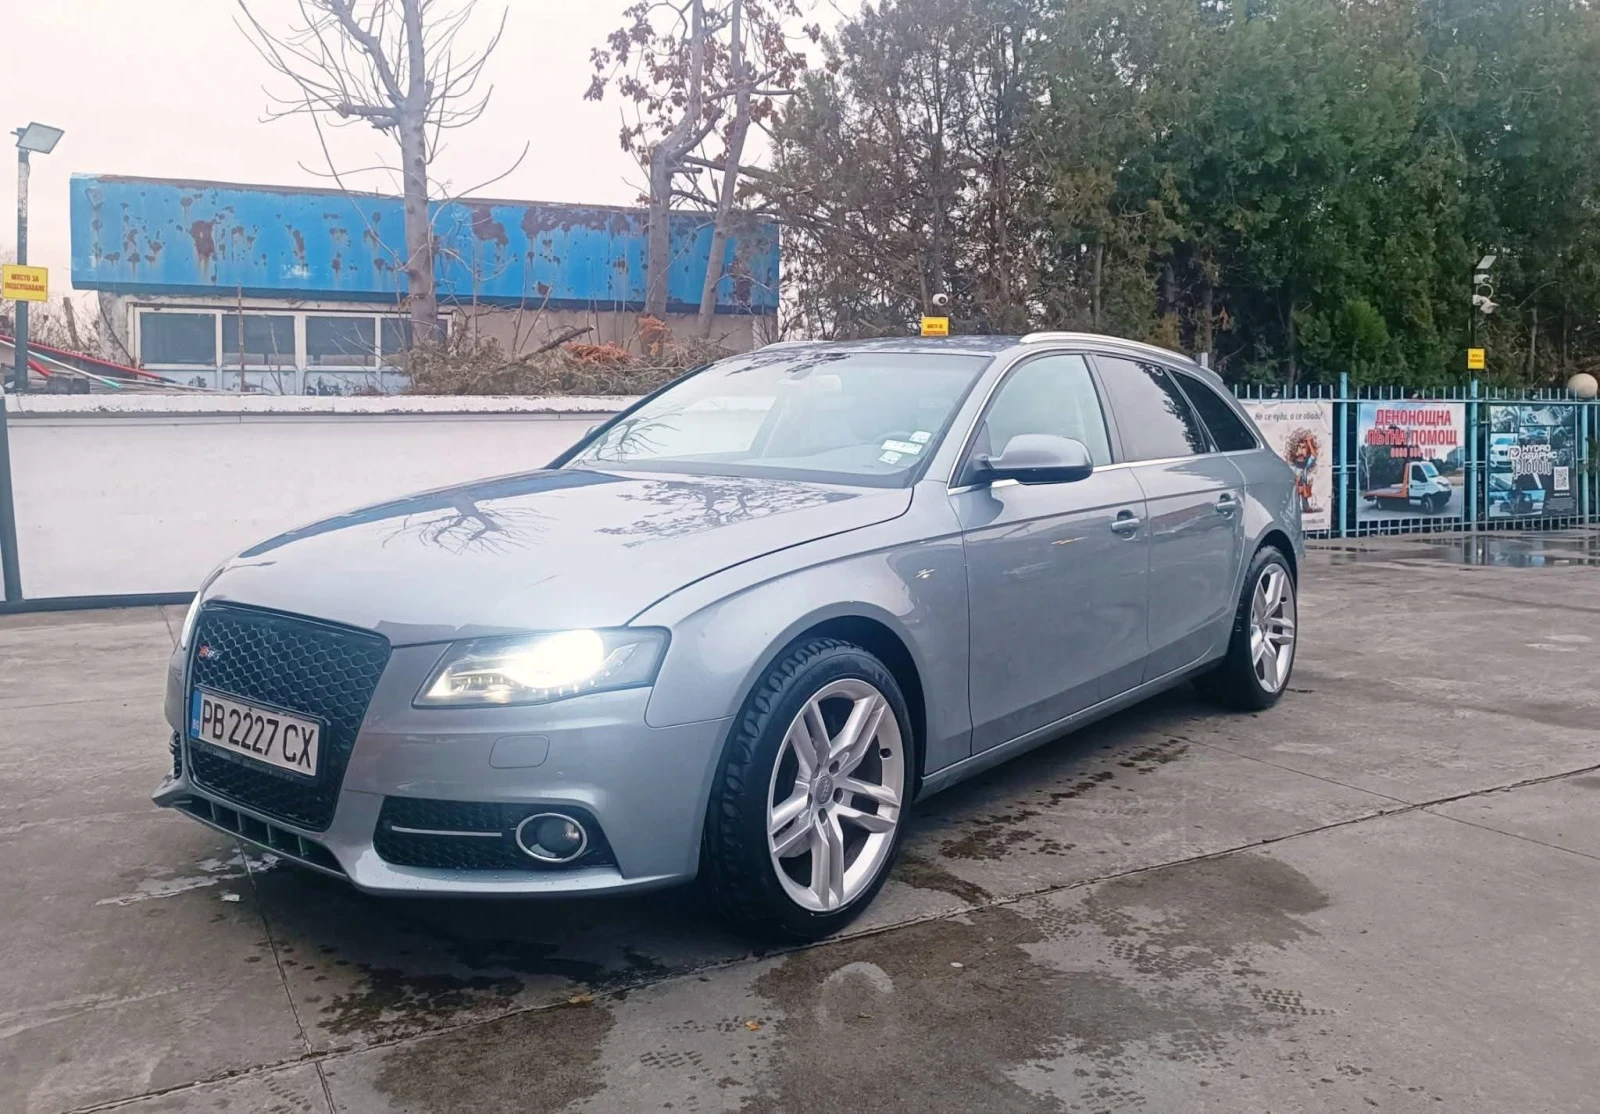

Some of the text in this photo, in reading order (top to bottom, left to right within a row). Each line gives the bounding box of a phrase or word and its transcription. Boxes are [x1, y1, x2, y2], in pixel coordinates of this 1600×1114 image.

[1375, 409, 1451, 427] ДЕНОНОЩНА
[1367, 429, 1457, 446] ПЪТНА ПОМОЩ
[1521, 451, 1557, 460] GRAPHIC
[1522, 444, 1551, 453] HYDRO
[202, 699, 315, 769] PB 2227 CX
